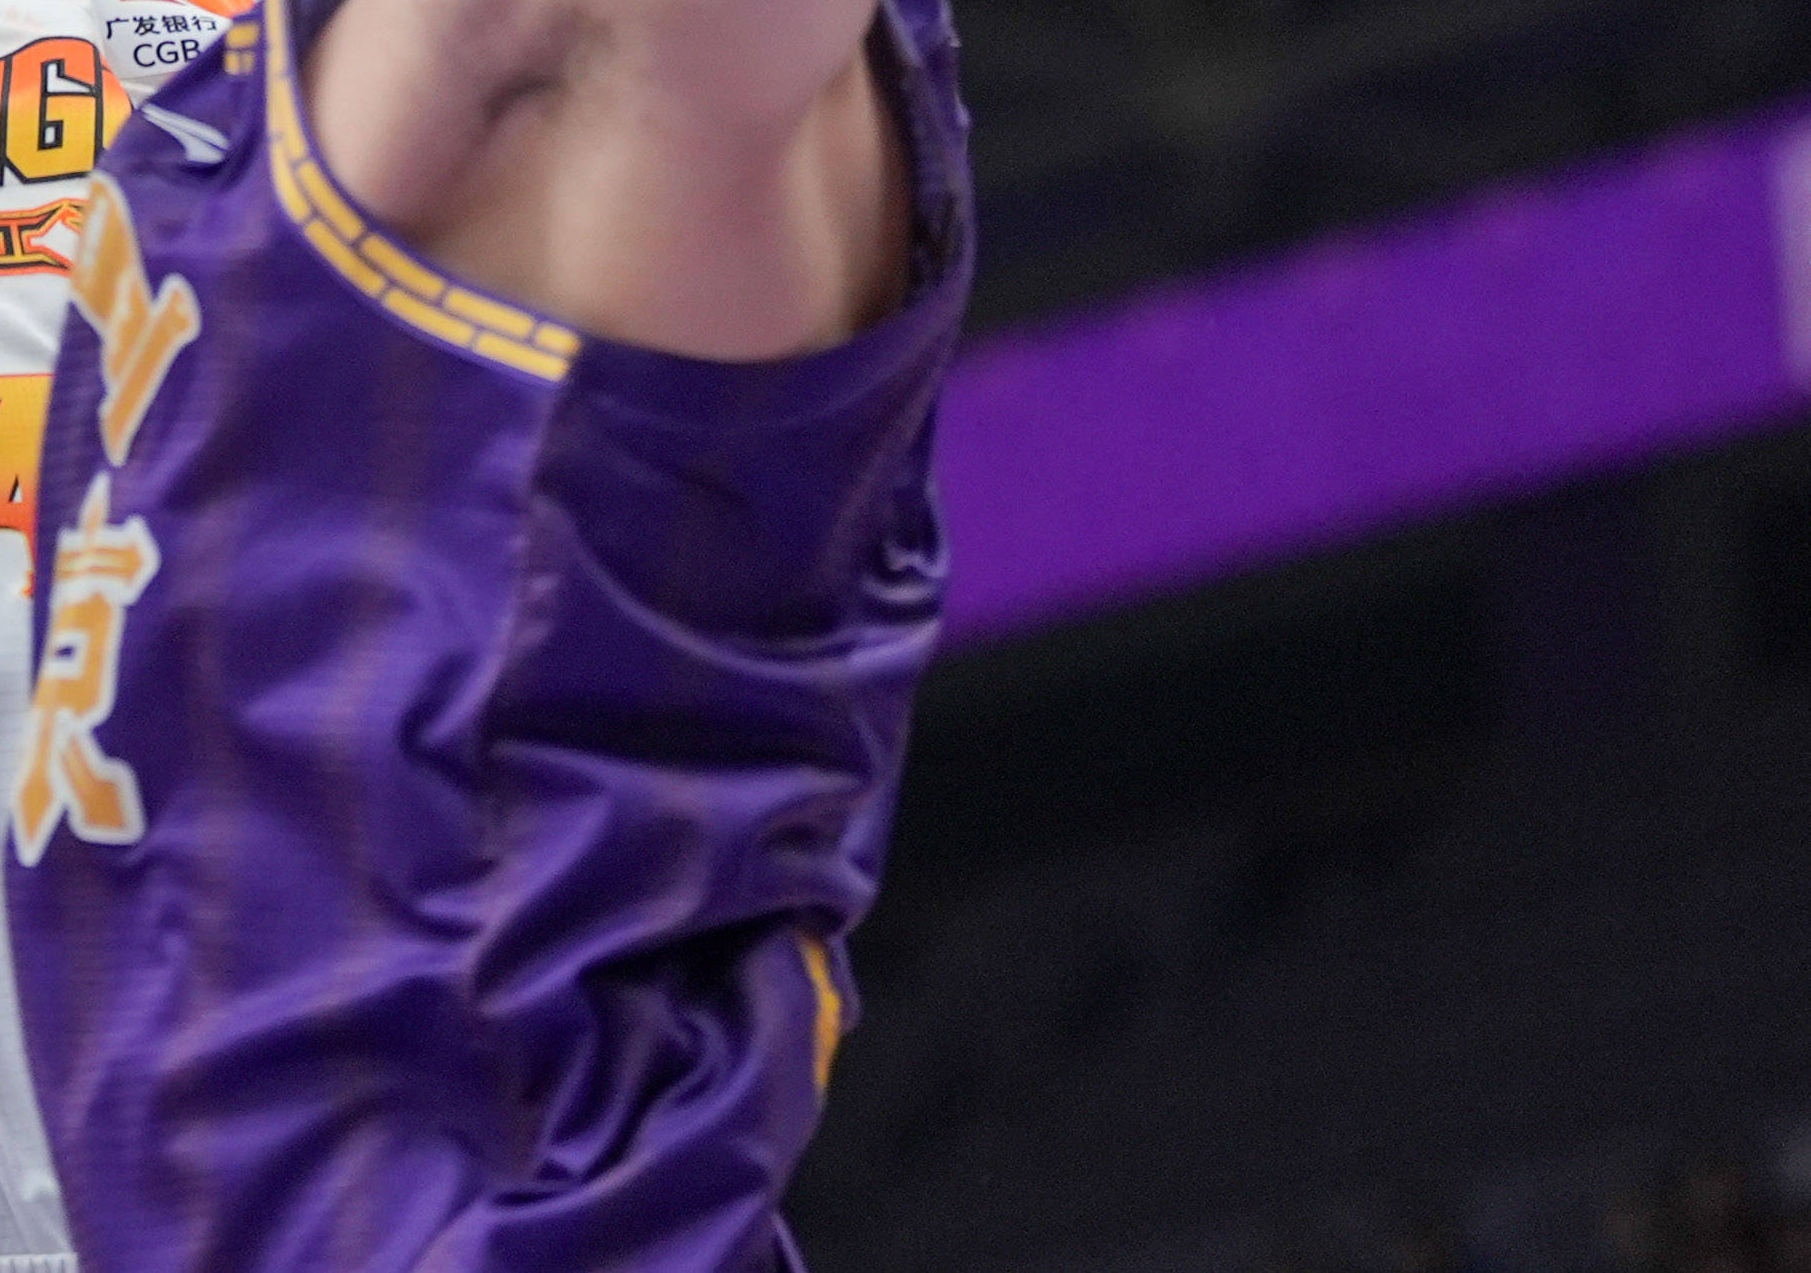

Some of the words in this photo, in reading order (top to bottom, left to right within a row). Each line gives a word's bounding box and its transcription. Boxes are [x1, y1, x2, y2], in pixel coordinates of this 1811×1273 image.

[105, 15, 217, 40] 广发银行
[132, 39, 204, 67] CGB
